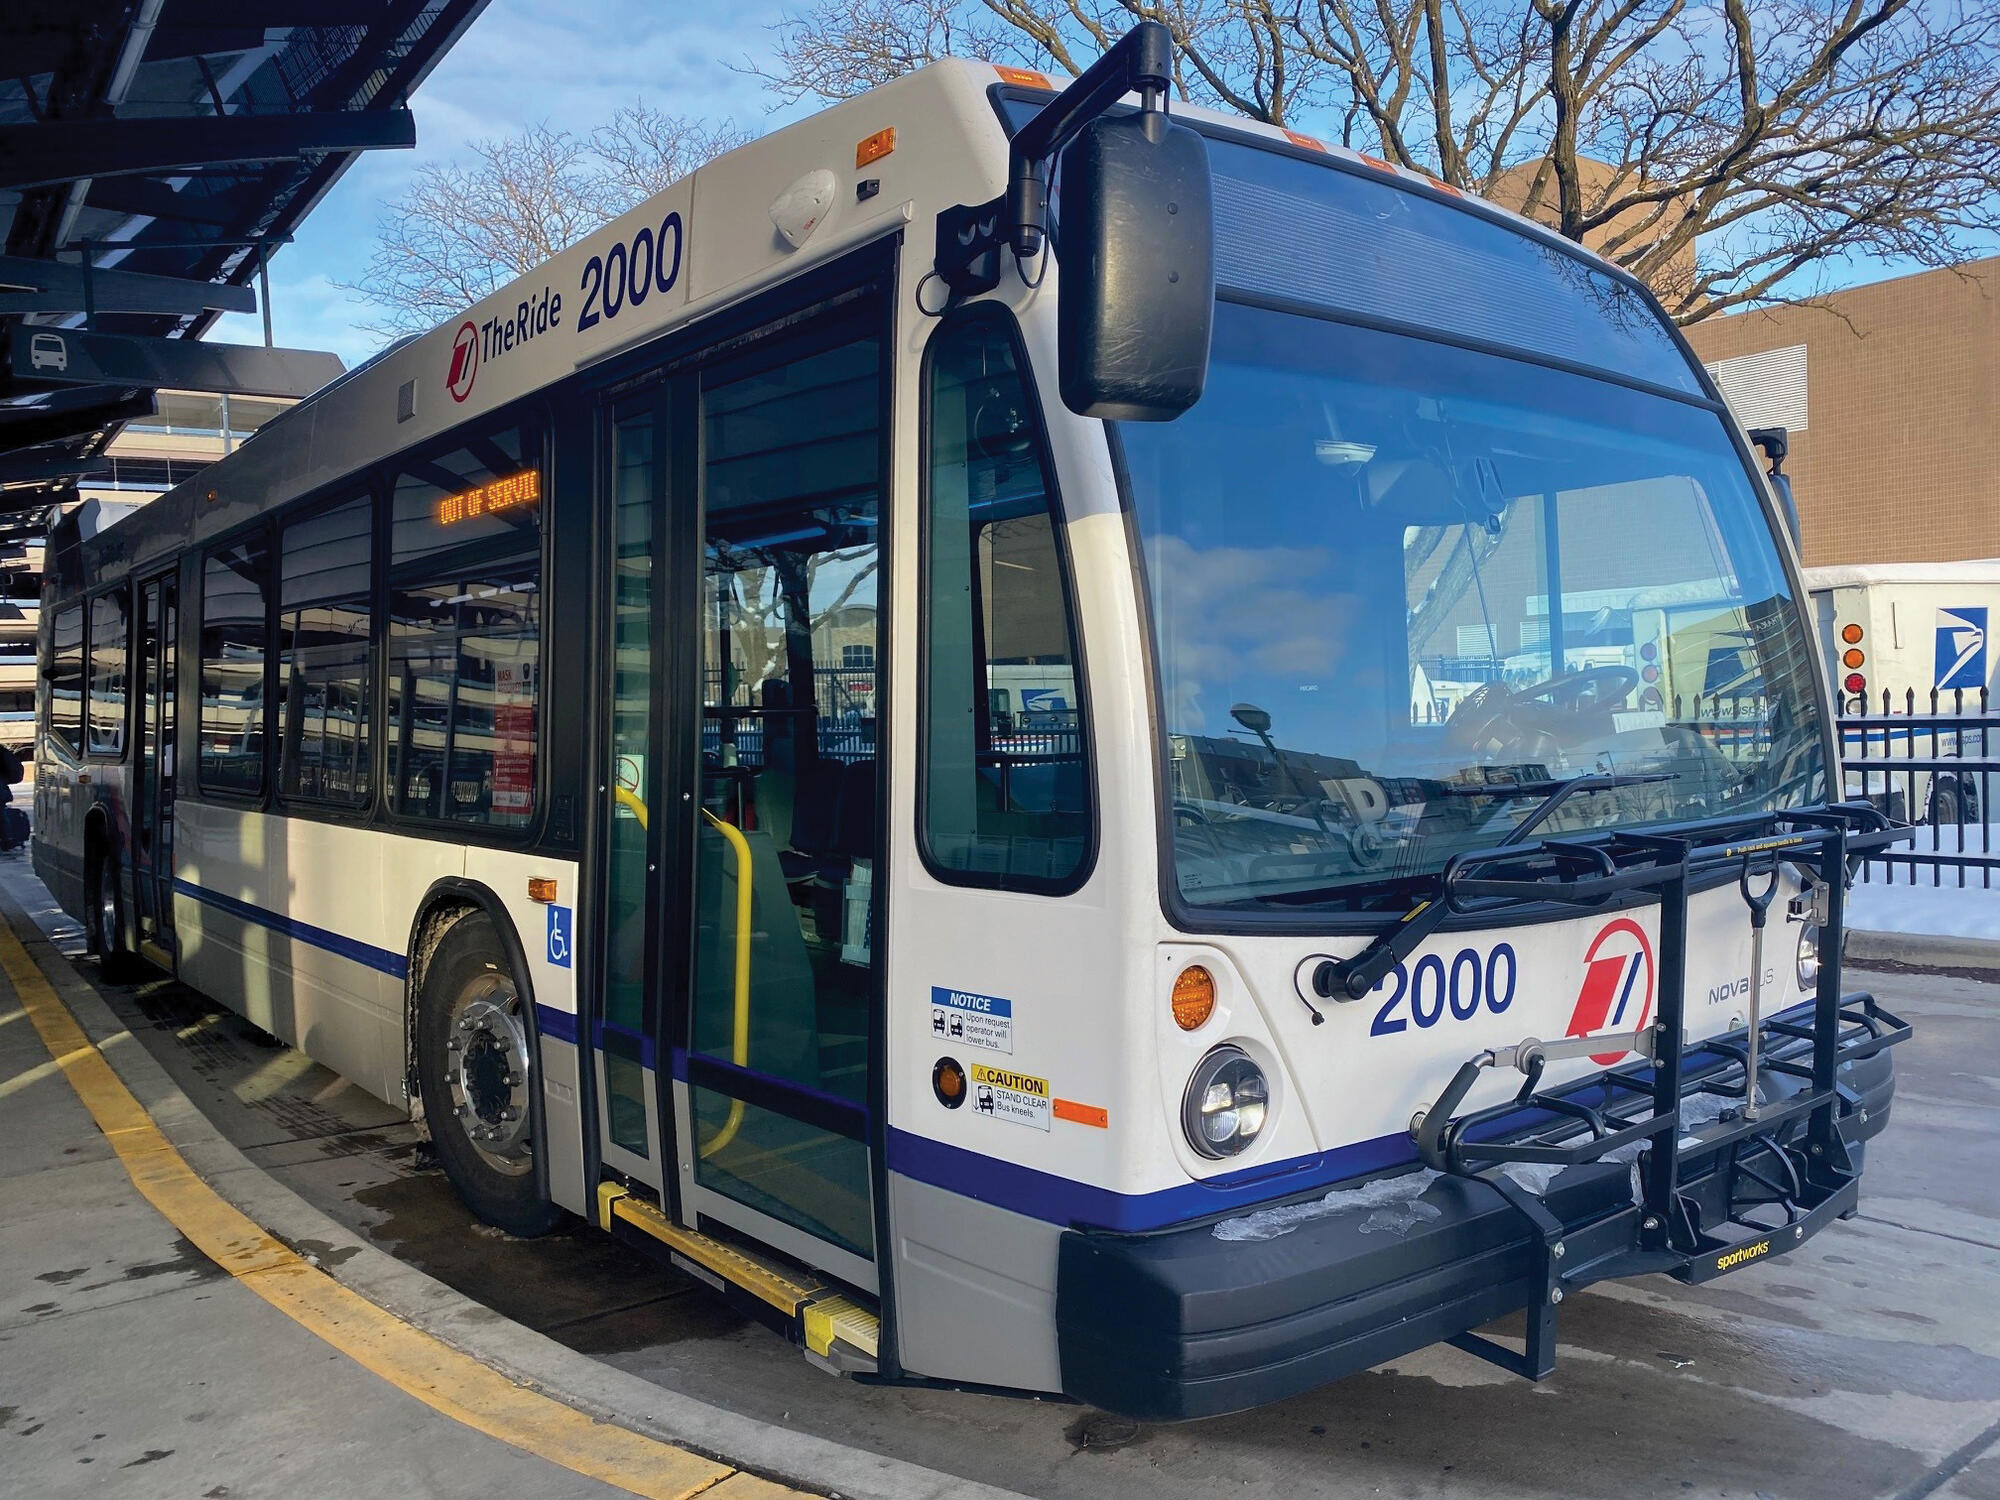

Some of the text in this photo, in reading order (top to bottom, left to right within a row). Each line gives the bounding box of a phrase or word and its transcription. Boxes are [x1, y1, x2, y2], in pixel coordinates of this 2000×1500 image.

[481, 211, 683, 363] TheRide 2000
[440, 494, 464, 525] OUT
[467, 488, 484, 516] OF
[1370, 942, 1517, 1037] 2000
[950, 992, 991, 1011] NOTICE
[966, 1013, 1011, 1030] Upon request
[966, 1024, 1007, 1039] operator will
[966, 1035, 1000, 1049] lower bus.
[987, 1070, 1043, 1094] CAUTION
[996, 1090, 1047, 1111] STAND CLEAR
[997, 1100, 1036, 1119] Bus kneels.
[1717, 1240, 1770, 1270] sportworks
